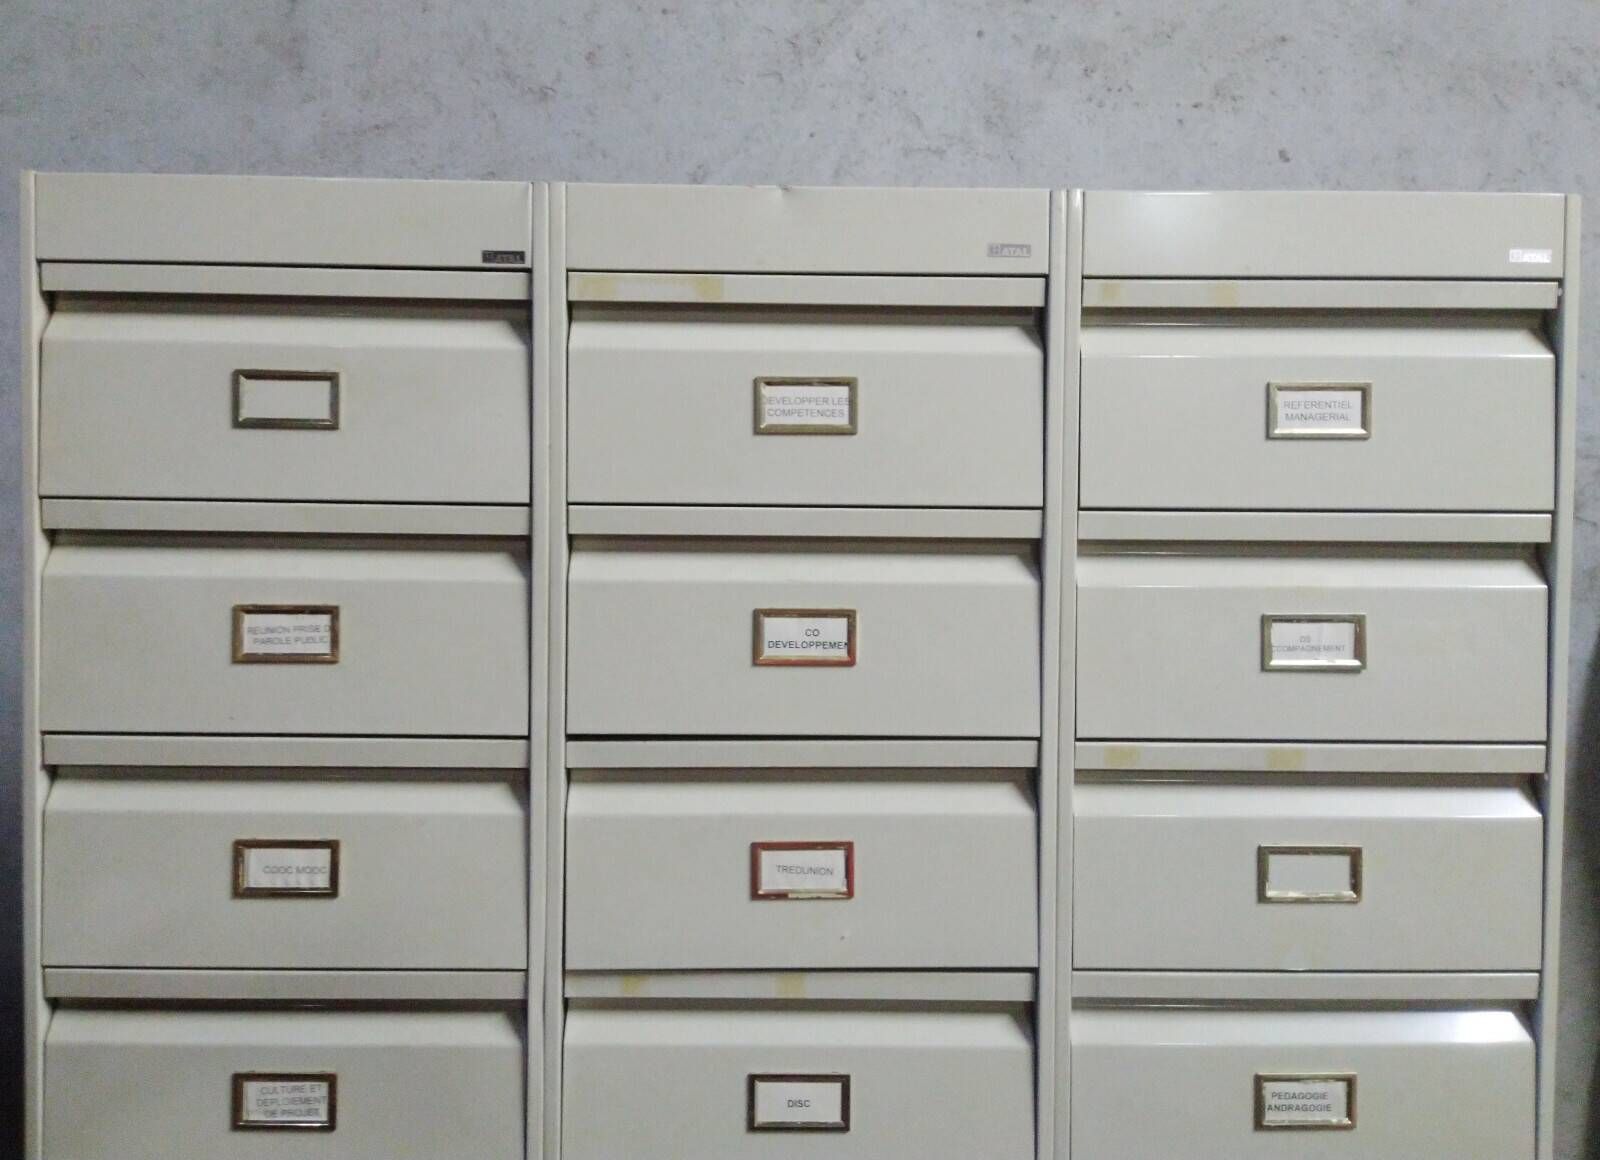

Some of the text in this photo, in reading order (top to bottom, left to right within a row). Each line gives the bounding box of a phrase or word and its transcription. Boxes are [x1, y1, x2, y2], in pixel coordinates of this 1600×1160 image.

[1283, 400, 1351, 410] REFERENTIEL
[767, 408, 844, 418] COMPETENCES
[1284, 412, 1350, 422] MANAGERIAL
[247, 625, 291, 635] REUNION
[804, 628, 820, 637] CO
[253, 637, 291, 645] PAROLE
[260, 1084, 322, 1095] CULTURE ET
[1271, 1091, 1329, 1100] PEDAGOGIE
[787, 1099, 812, 1109] DISC
[1266, 1103, 1333, 1112] ANDRAGOGIE
